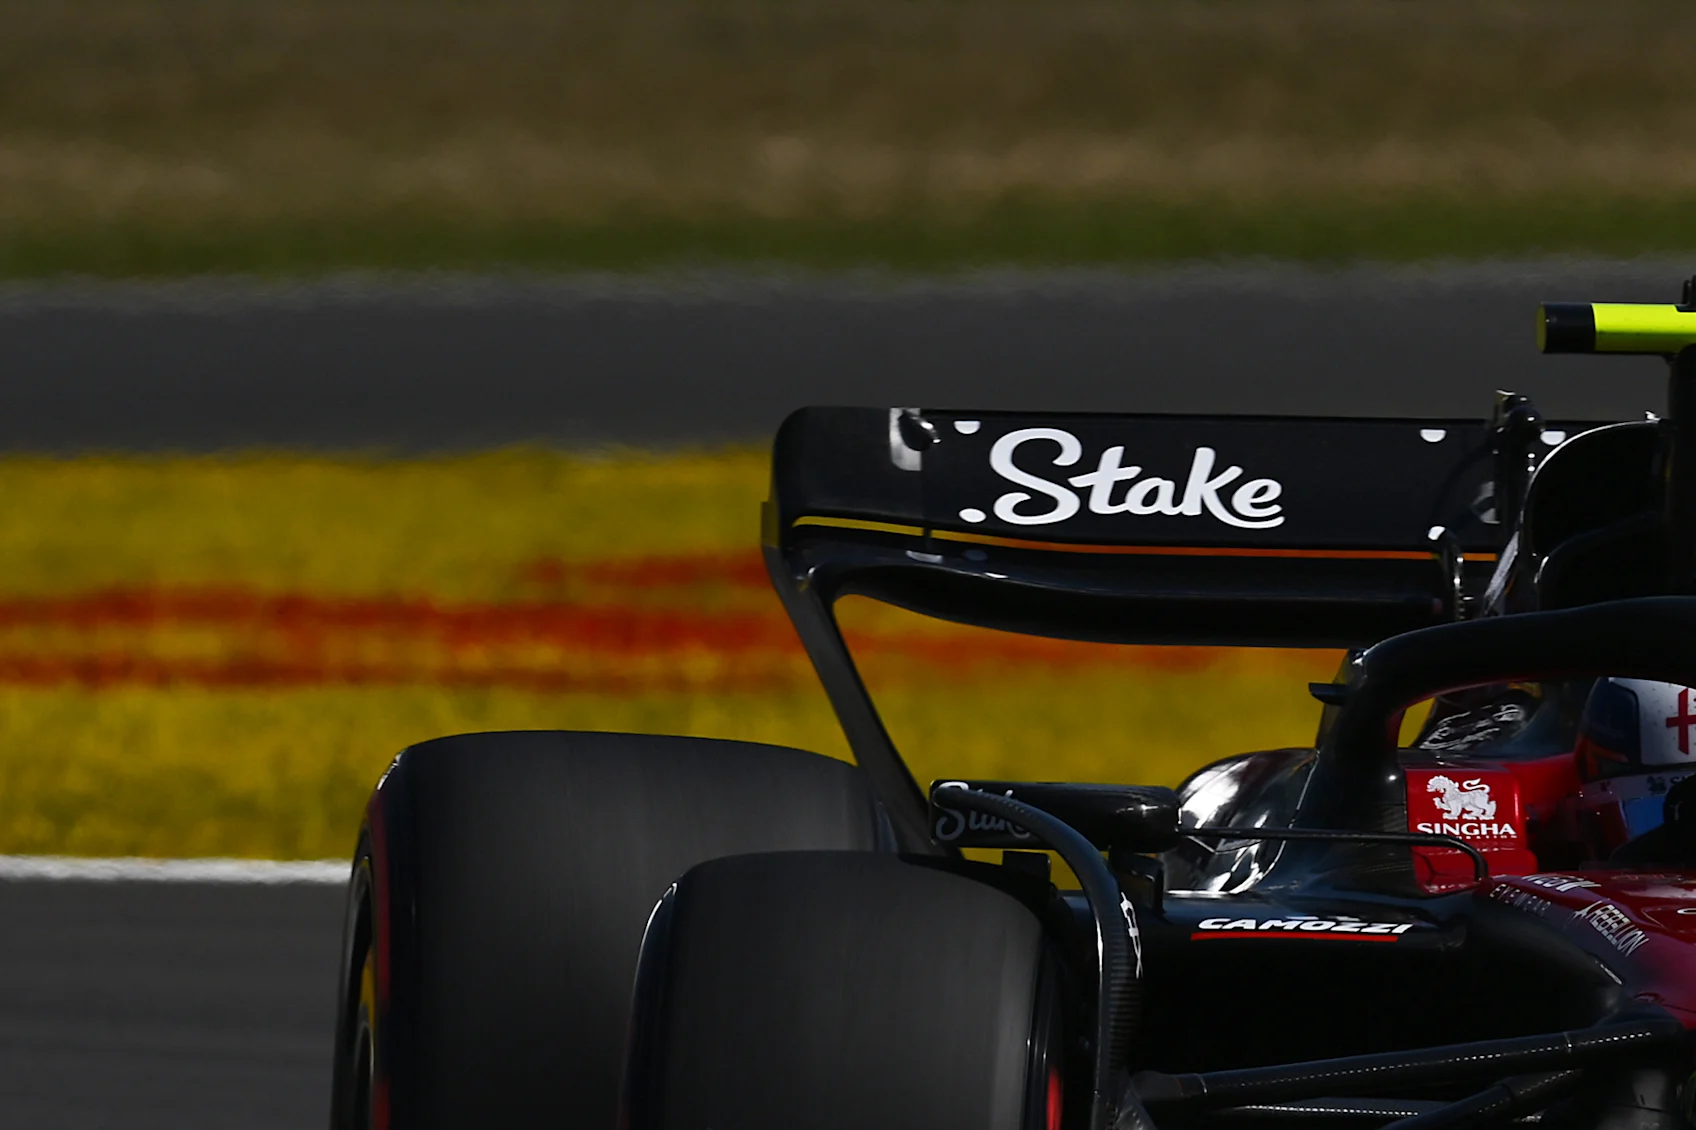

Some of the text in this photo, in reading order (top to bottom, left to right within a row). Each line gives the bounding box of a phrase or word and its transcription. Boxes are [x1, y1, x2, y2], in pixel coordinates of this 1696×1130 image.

[990, 428, 1285, 529] Stake
[1416, 822, 1517, 837] SINGHA
[1197, 917, 1414, 934] CAMOZZI
